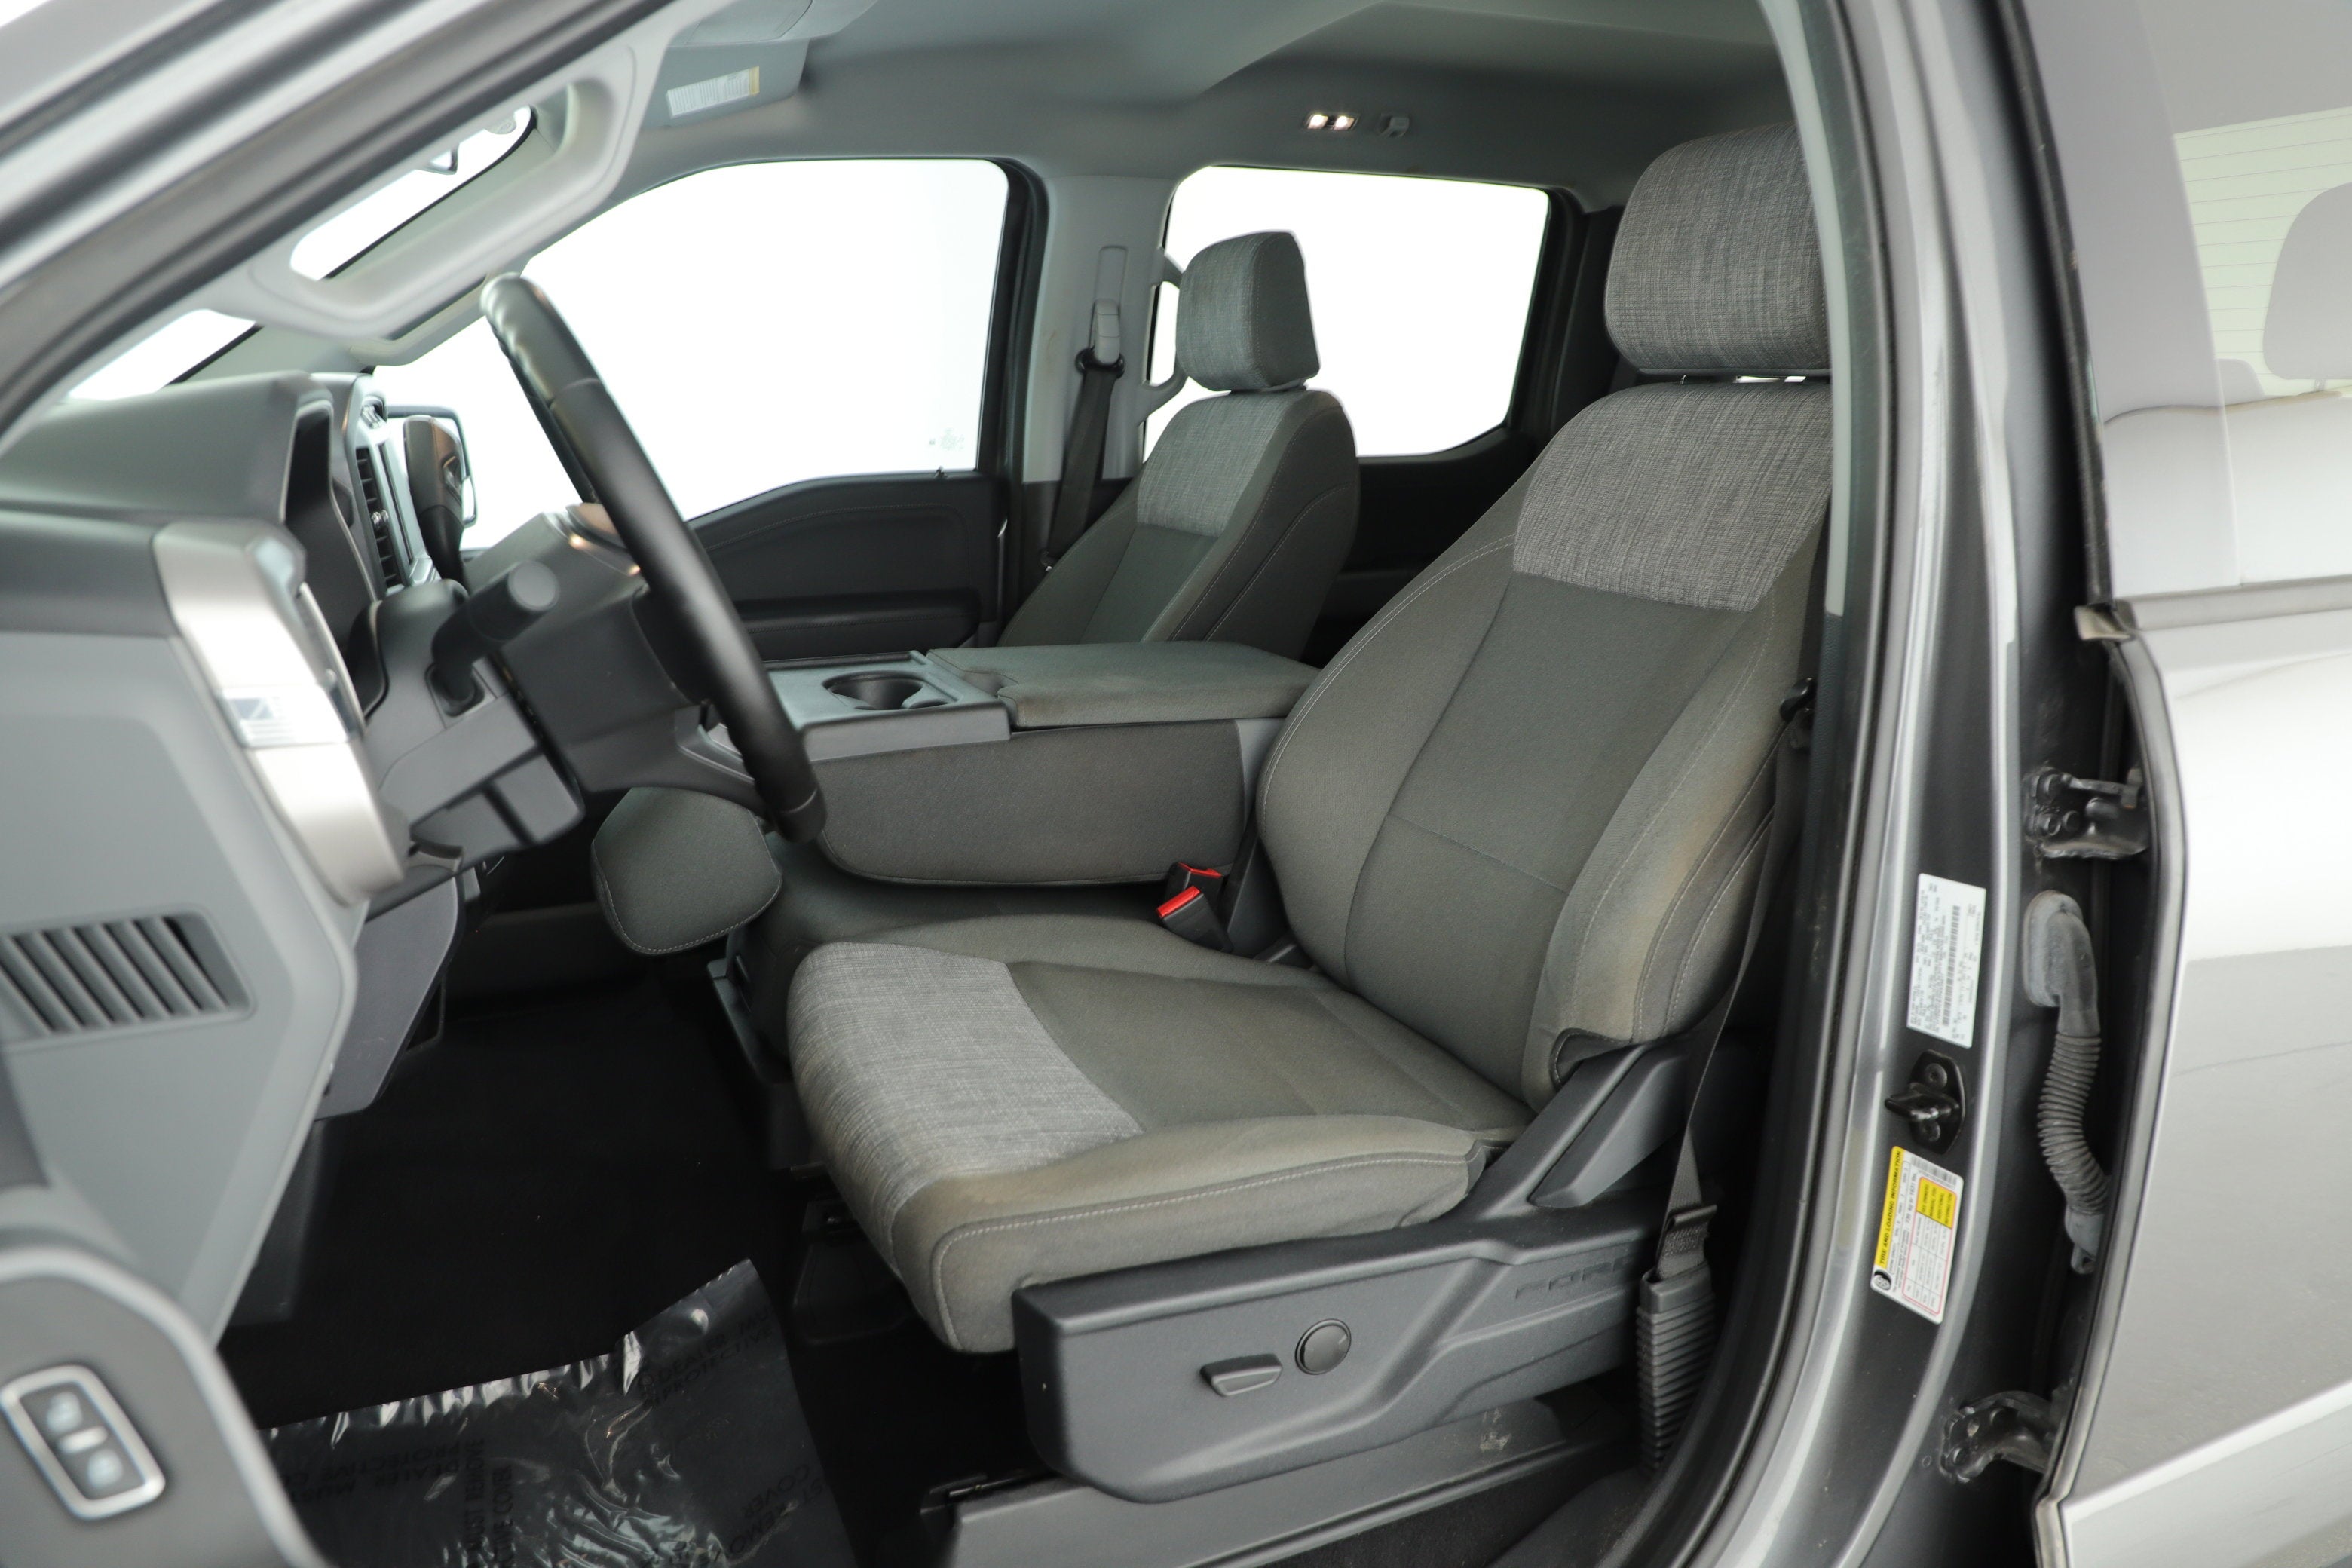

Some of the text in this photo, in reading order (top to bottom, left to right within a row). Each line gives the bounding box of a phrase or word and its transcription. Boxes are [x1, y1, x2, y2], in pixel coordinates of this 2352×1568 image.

[1884, 1201, 1894, 1231] LOADING
[1889, 1150, 1902, 1199] INFORMATION
[658, 1333, 725, 1382] DEALER
[375, 1458, 459, 1489] DEALER
[742, 1464, 810, 1520] COVER
